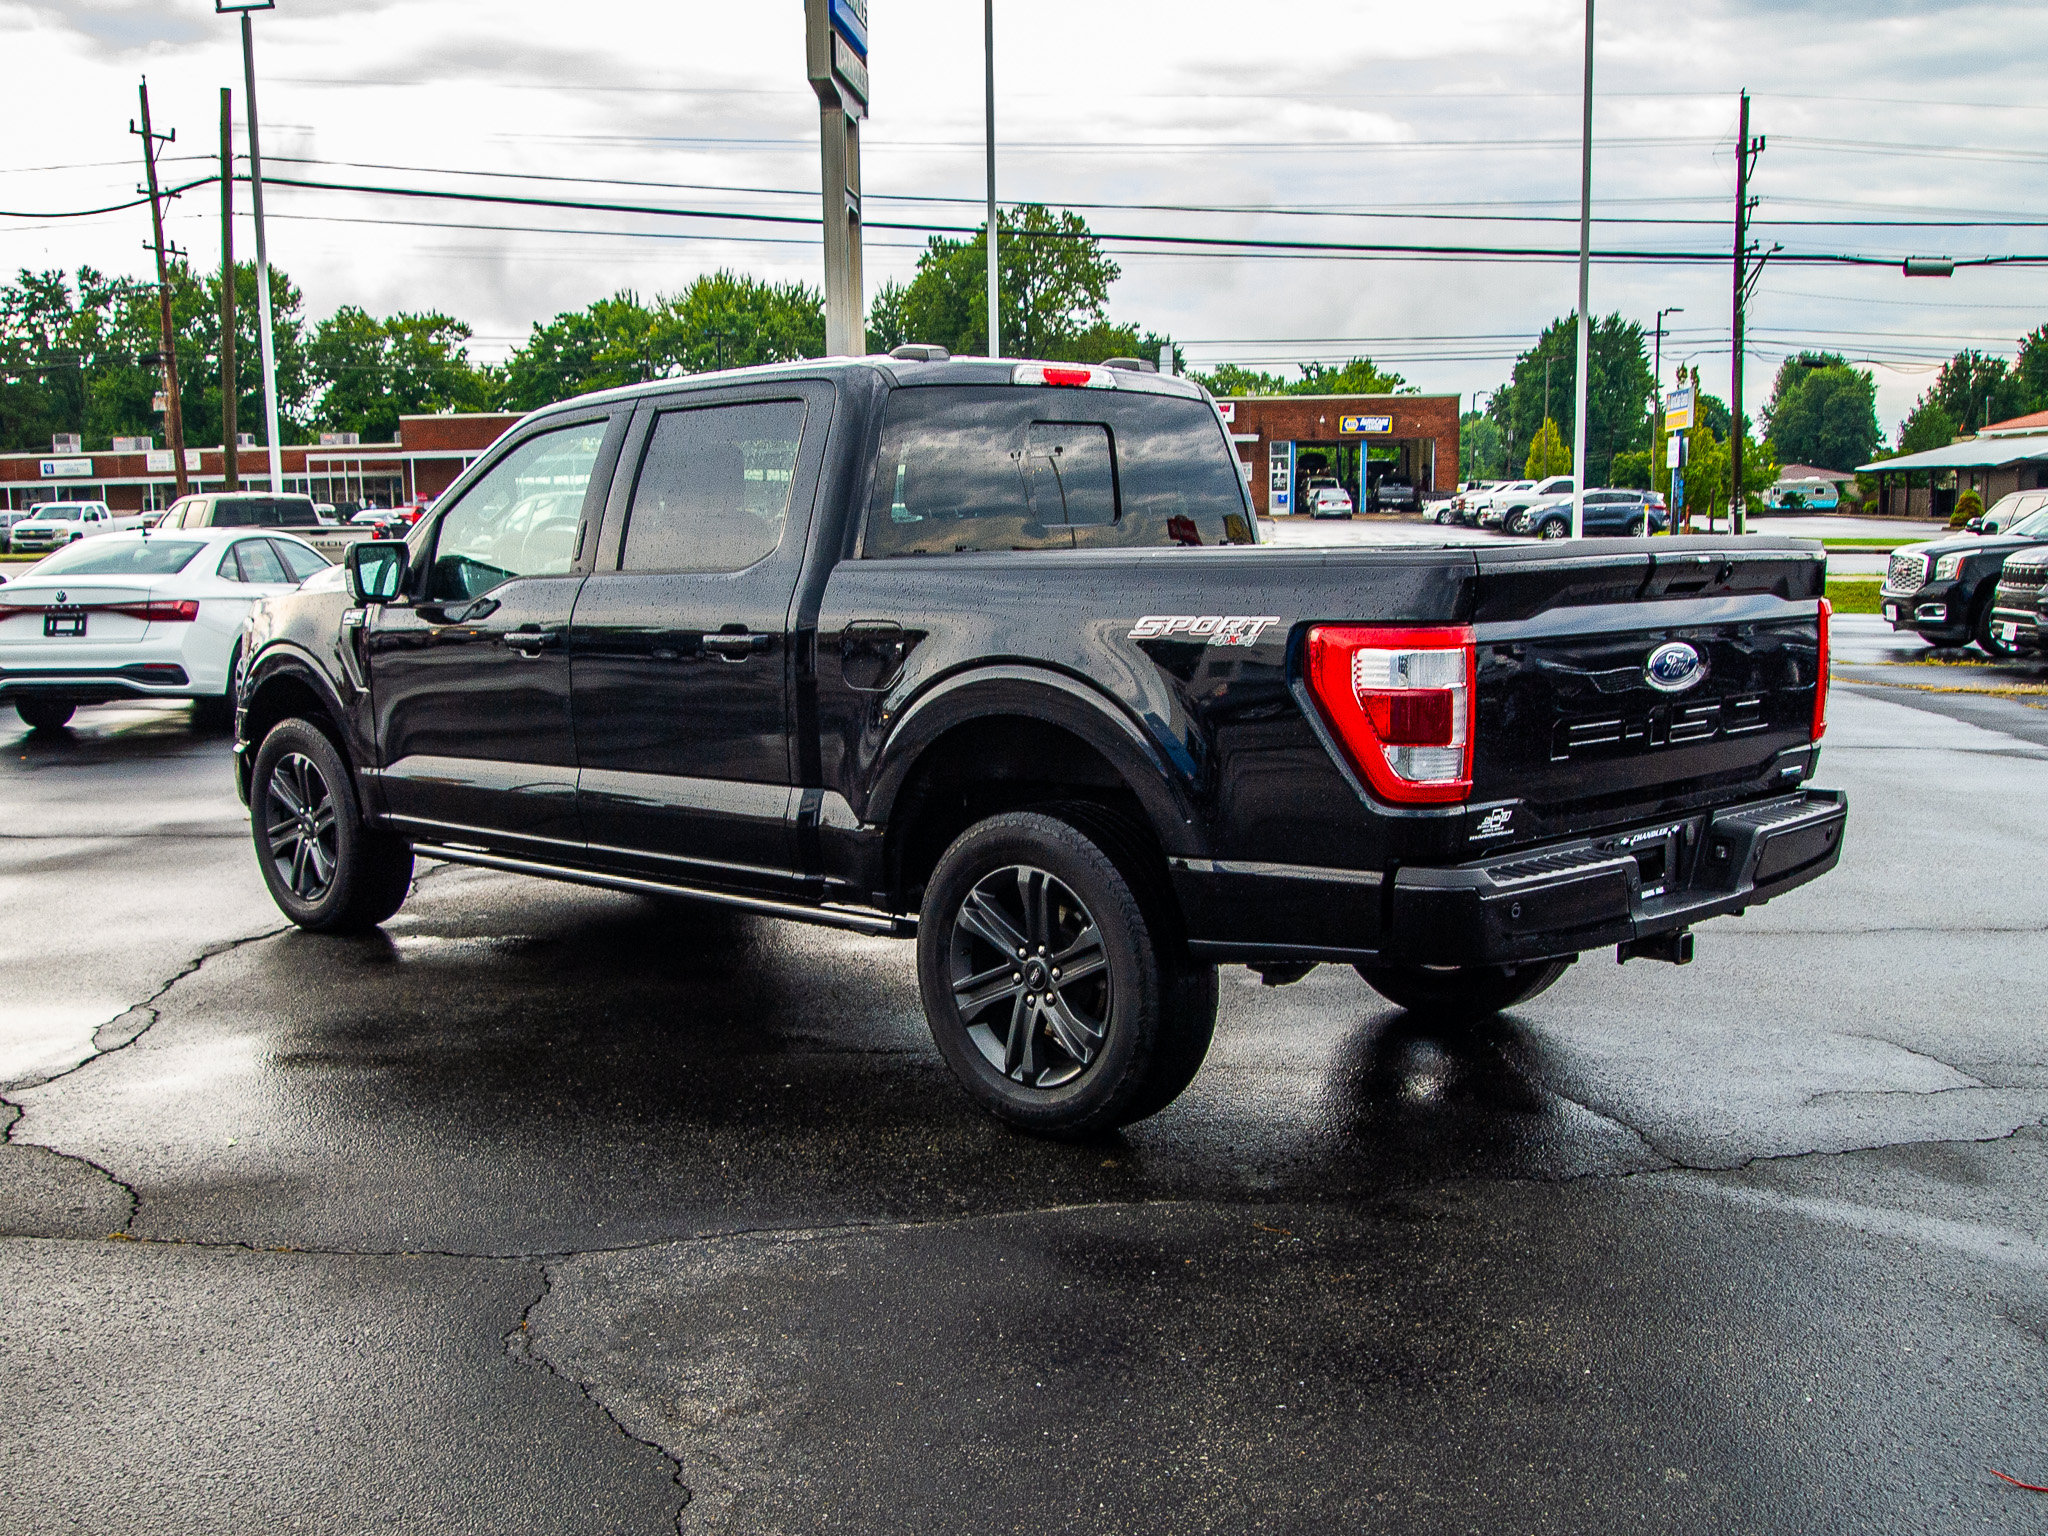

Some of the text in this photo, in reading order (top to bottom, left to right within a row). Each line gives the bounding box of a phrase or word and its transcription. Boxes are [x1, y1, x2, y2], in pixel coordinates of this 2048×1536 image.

[1127, 615, 1281, 640] SPORT
[1663, 651, 1692, 676] Ford
[1550, 691, 1769, 761] F-150
[1632, 827, 1669, 843] CHANDLER
